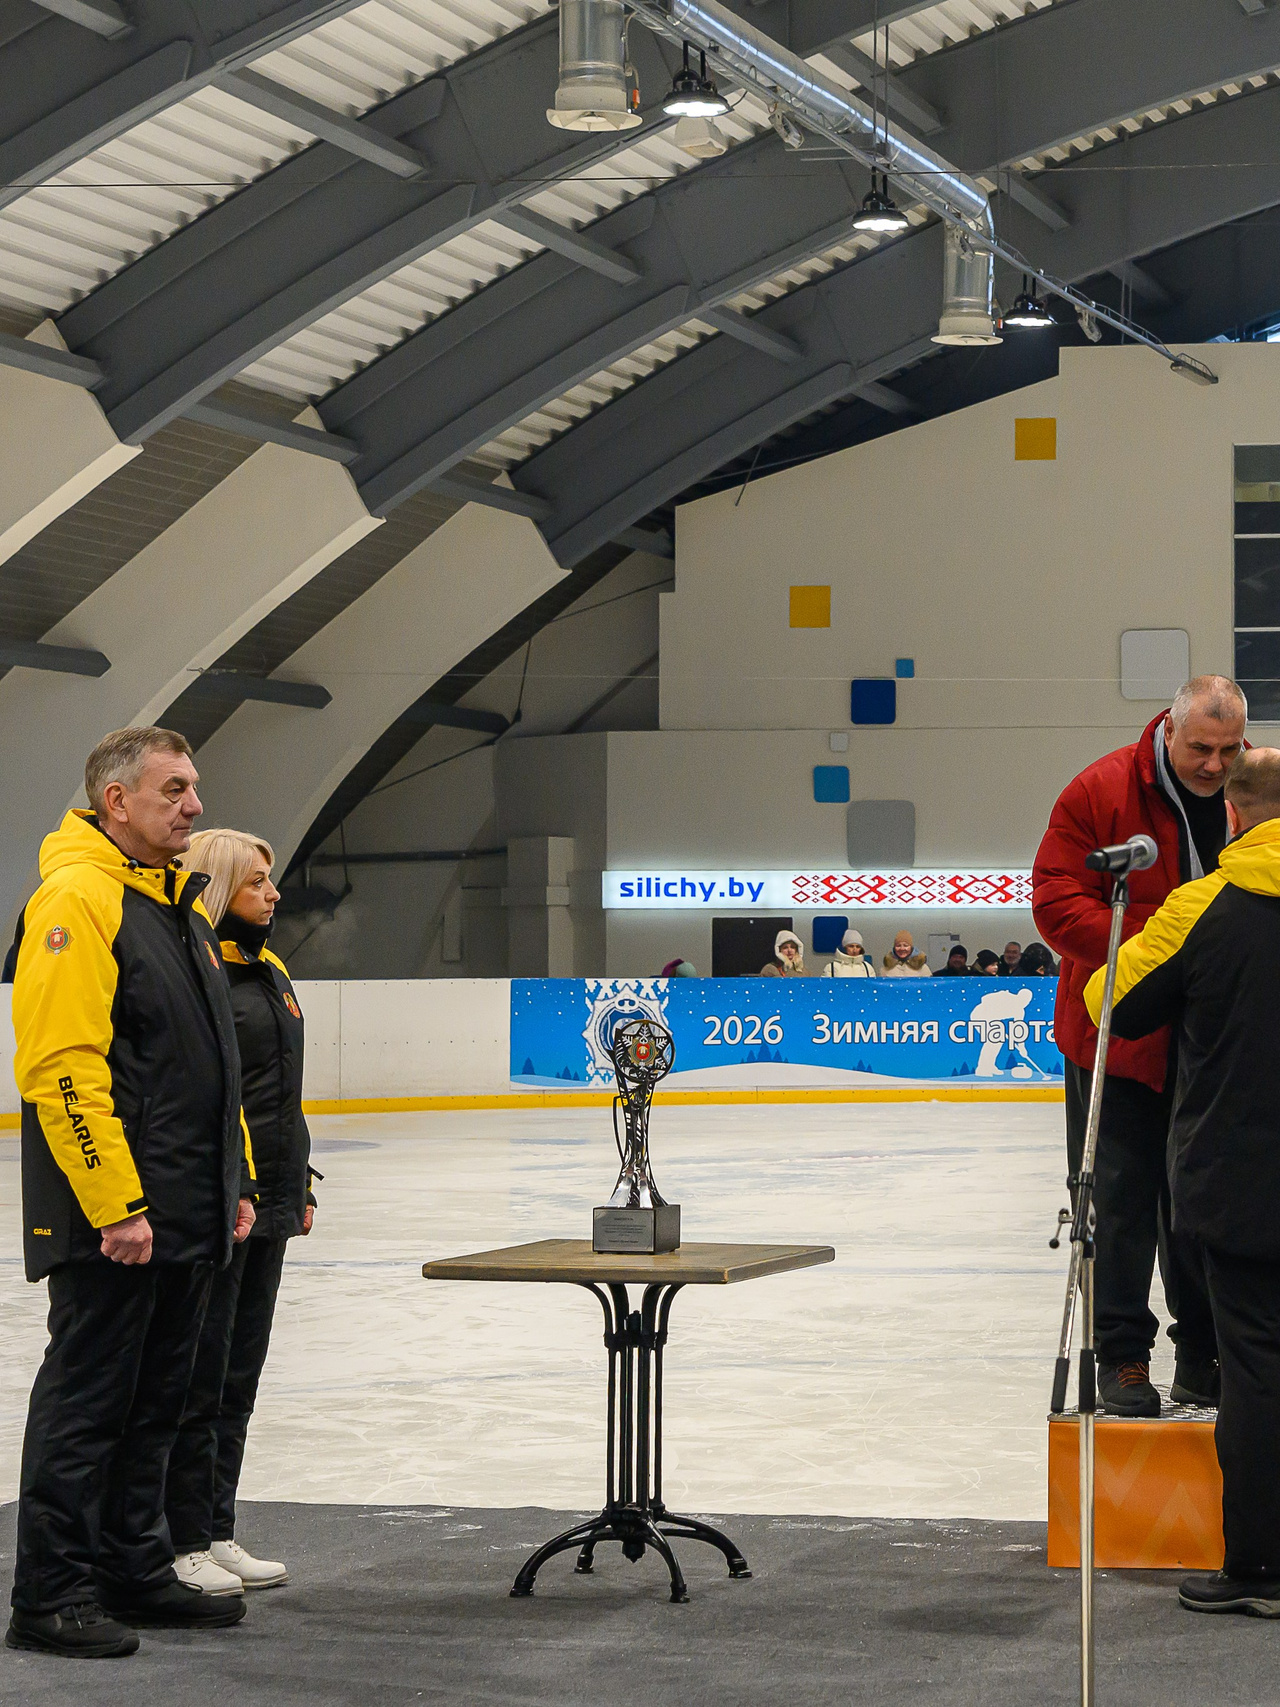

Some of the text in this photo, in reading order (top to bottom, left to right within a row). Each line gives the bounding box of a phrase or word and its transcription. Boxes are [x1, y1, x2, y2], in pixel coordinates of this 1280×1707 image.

[620, 877, 765, 902] silichy.by
[703, 1015, 784, 1045] 2026
[812, 1013, 939, 1044] Зимняя
[58, 1075, 102, 1170] BELARUS
